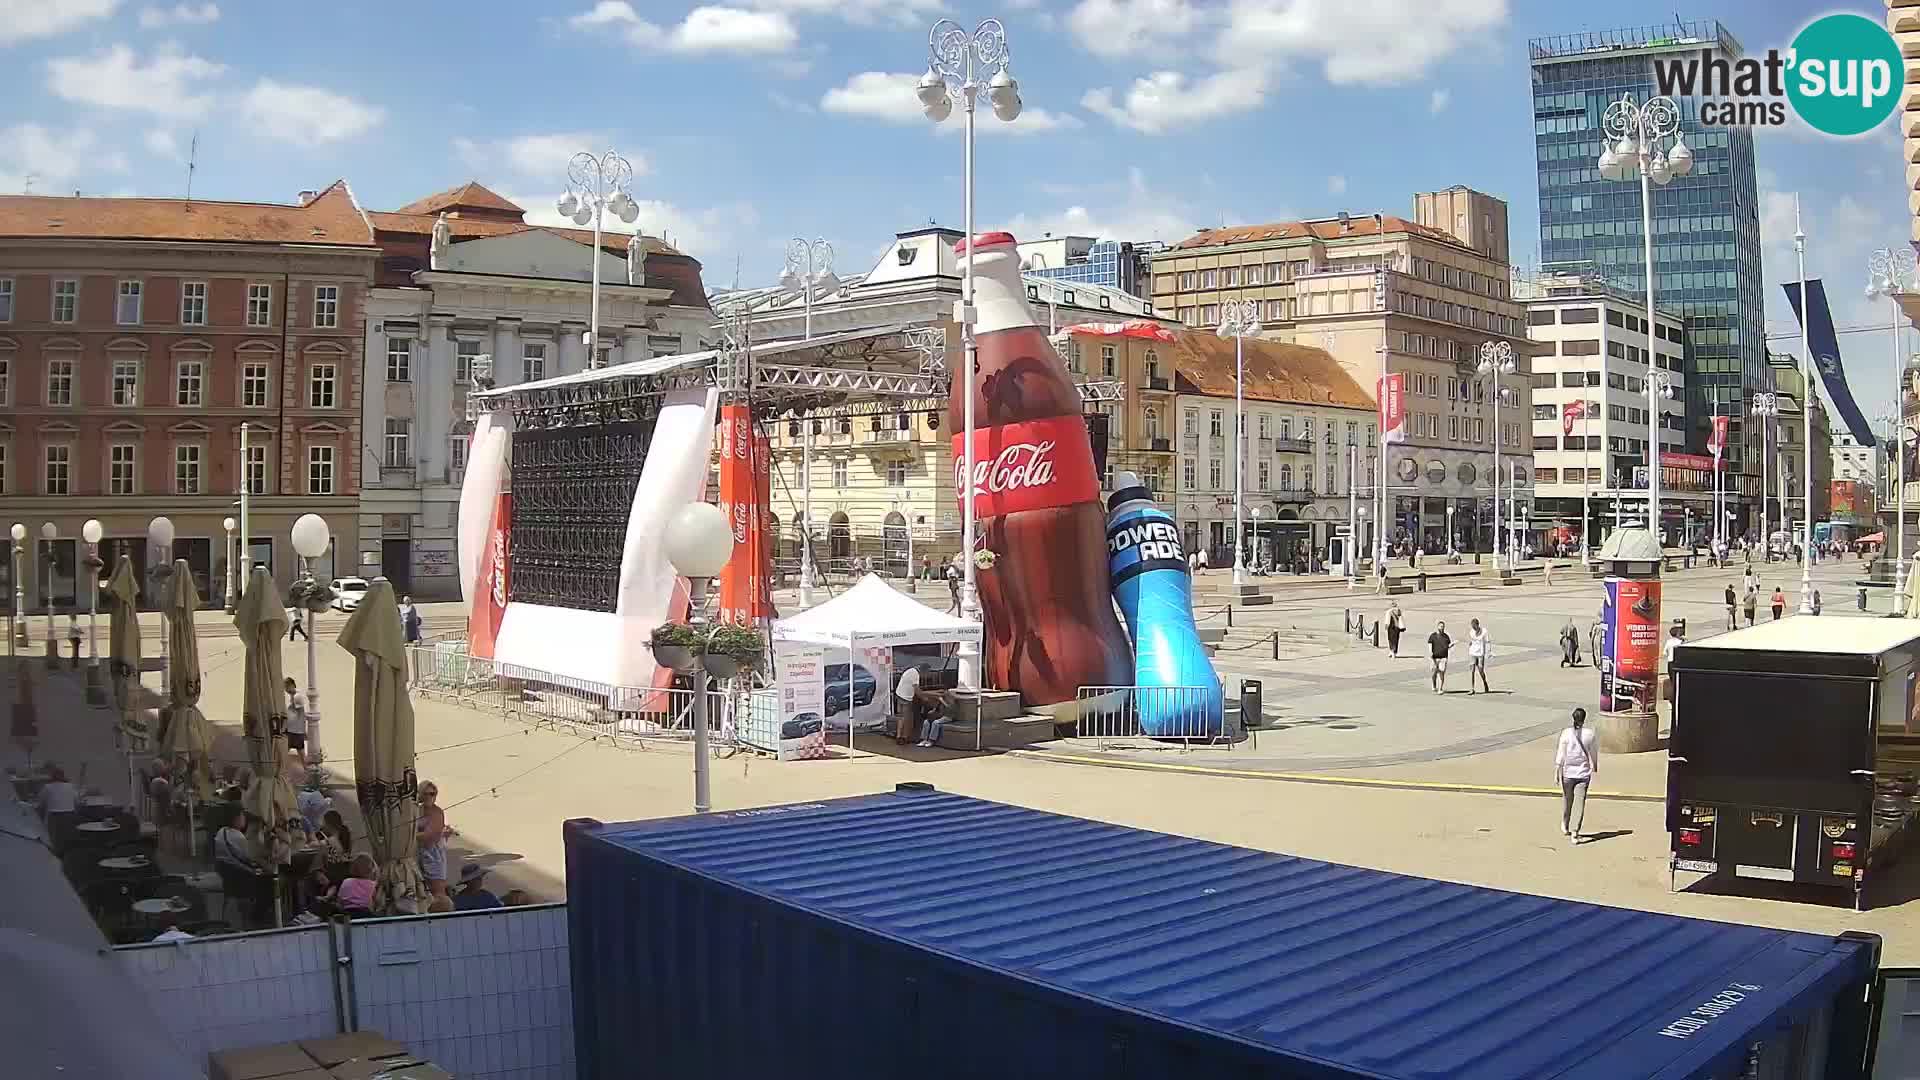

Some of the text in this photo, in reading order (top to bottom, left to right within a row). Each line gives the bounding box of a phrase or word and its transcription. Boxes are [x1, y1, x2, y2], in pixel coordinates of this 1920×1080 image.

[735, 416, 747, 459] Coca-Cola
[955, 440, 1056, 499] Coa-Cola
[1140, 540, 1184, 561] ADE
[1691, 990, 1747, 1018] 300629
